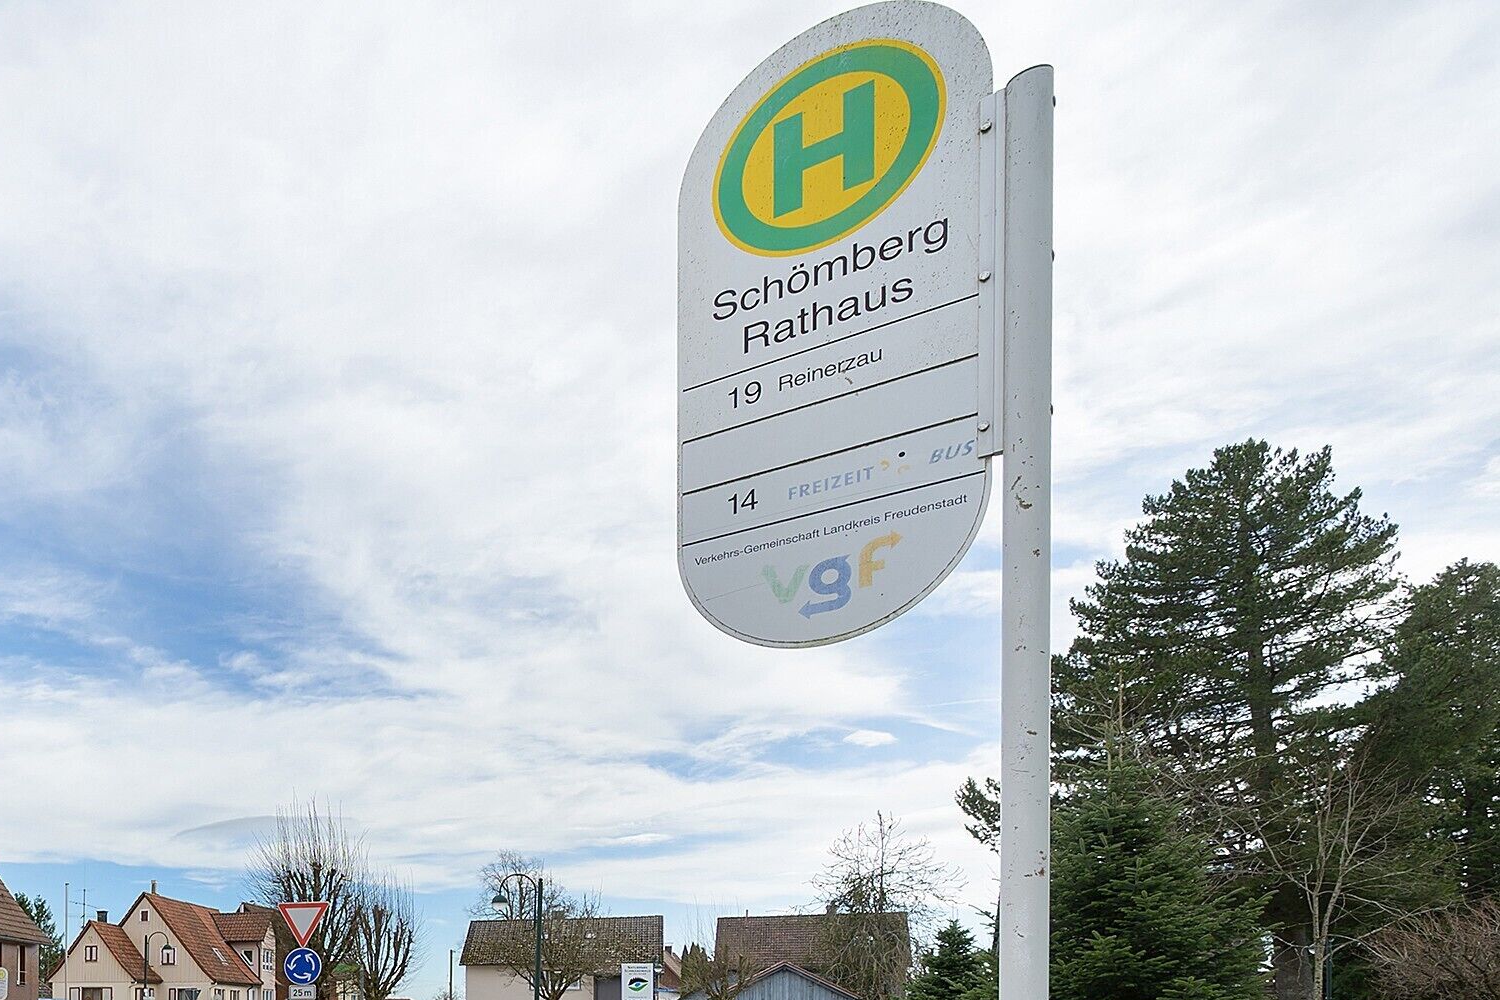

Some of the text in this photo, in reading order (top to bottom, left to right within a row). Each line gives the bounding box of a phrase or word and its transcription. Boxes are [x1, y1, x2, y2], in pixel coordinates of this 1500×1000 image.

[773, 79, 876, 219] H
[712, 217, 949, 321] Schömberg
[743, 277, 914, 354] Rathaus
[728, 348, 883, 409] 19 Reinerzau
[728, 438, 975, 515] 14 FREIZEIT BUS
[694, 494, 968, 566] Verkehrs-Gemeinschaft Landkreis Freudenstadt
[760, 530, 904, 620] vgf
[293, 989, 303, 997] 25
